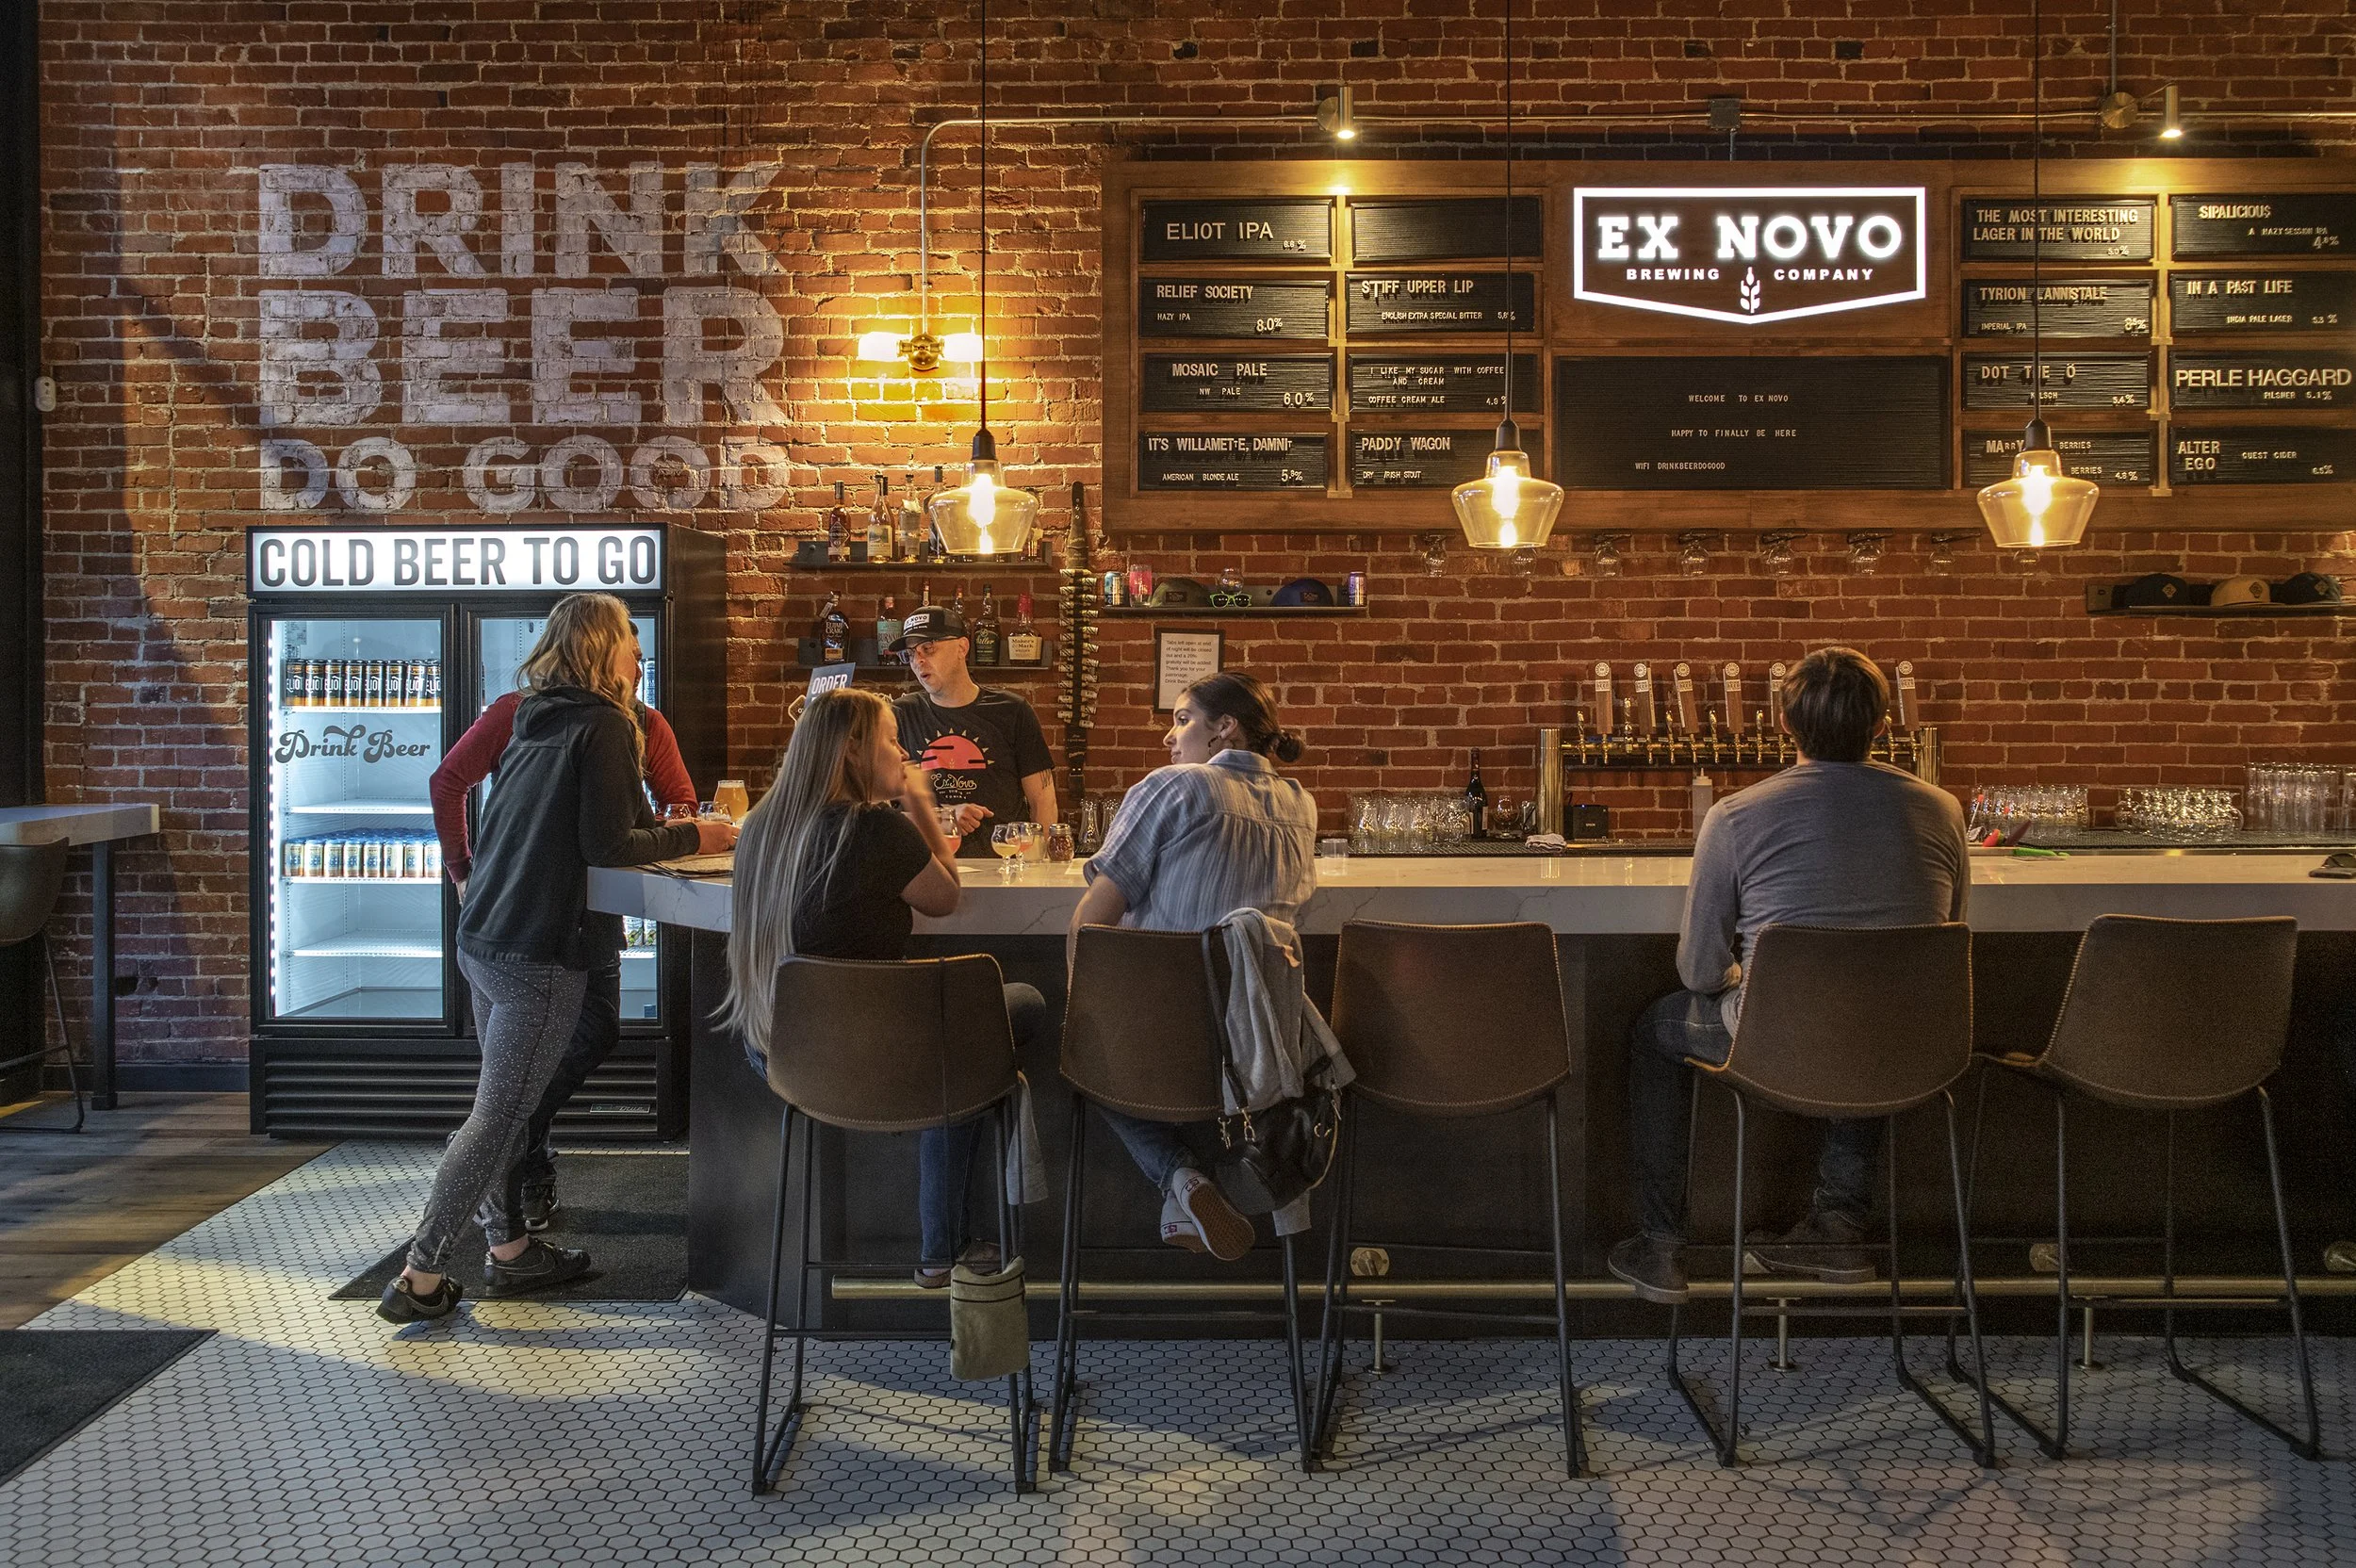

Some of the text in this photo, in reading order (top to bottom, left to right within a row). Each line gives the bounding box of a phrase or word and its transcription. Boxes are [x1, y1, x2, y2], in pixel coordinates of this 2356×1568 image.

[259, 161, 787, 276] DRINK
[1977, 209, 2137, 222] THE MOST INTERESTING
[2199, 205, 2271, 218] SIPALICIOUS
[1167, 221, 1274, 240] ELIOT IPA
[1598, 215, 1902, 259] EX NOVO
[1973, 227, 2120, 240] LAGER IN THE WORLD
[1627, 269, 1873, 281] BREWING COMPANY
[1157, 286, 1253, 299] RELIEF SOCIETY
[1362, 280, 1474, 298] STIFF UPPER LIP
[1980, 287, 2026, 301] TYRION
[2187, 280, 2292, 294] IN A PAST LIFE
[1179, 313, 1190, 321] IPA
[1256, 318, 1283, 332] 8.0%
[259, 286, 790, 426] BEER
[1172, 364, 1268, 376] MOSAIC PALE
[1381, 367, 1399, 375] LIKE
[1405, 367, 1415, 375] MY
[1420, 367, 1445, 375] SUGAR
[1982, 366, 2009, 378] DOT
[2025, 366, 2050, 378] TE
[2176, 368, 2352, 386] PERLE HAGGARD
[1149, 438, 1293, 452] IT'S WILLAMETTE, DAMNIT
[1362, 437, 1450, 450] PADDY WAGON
[2178, 441, 2220, 454] ALTER
[2185, 458, 2216, 470] EGO
[261, 435, 790, 512] DO GOOD
[260, 535, 657, 588] COLD BEER TO GO
[811, 674, 848, 694] ORDER
[275, 725, 430, 763] Drink Beer
[948, 774, 977, 791] Novo
